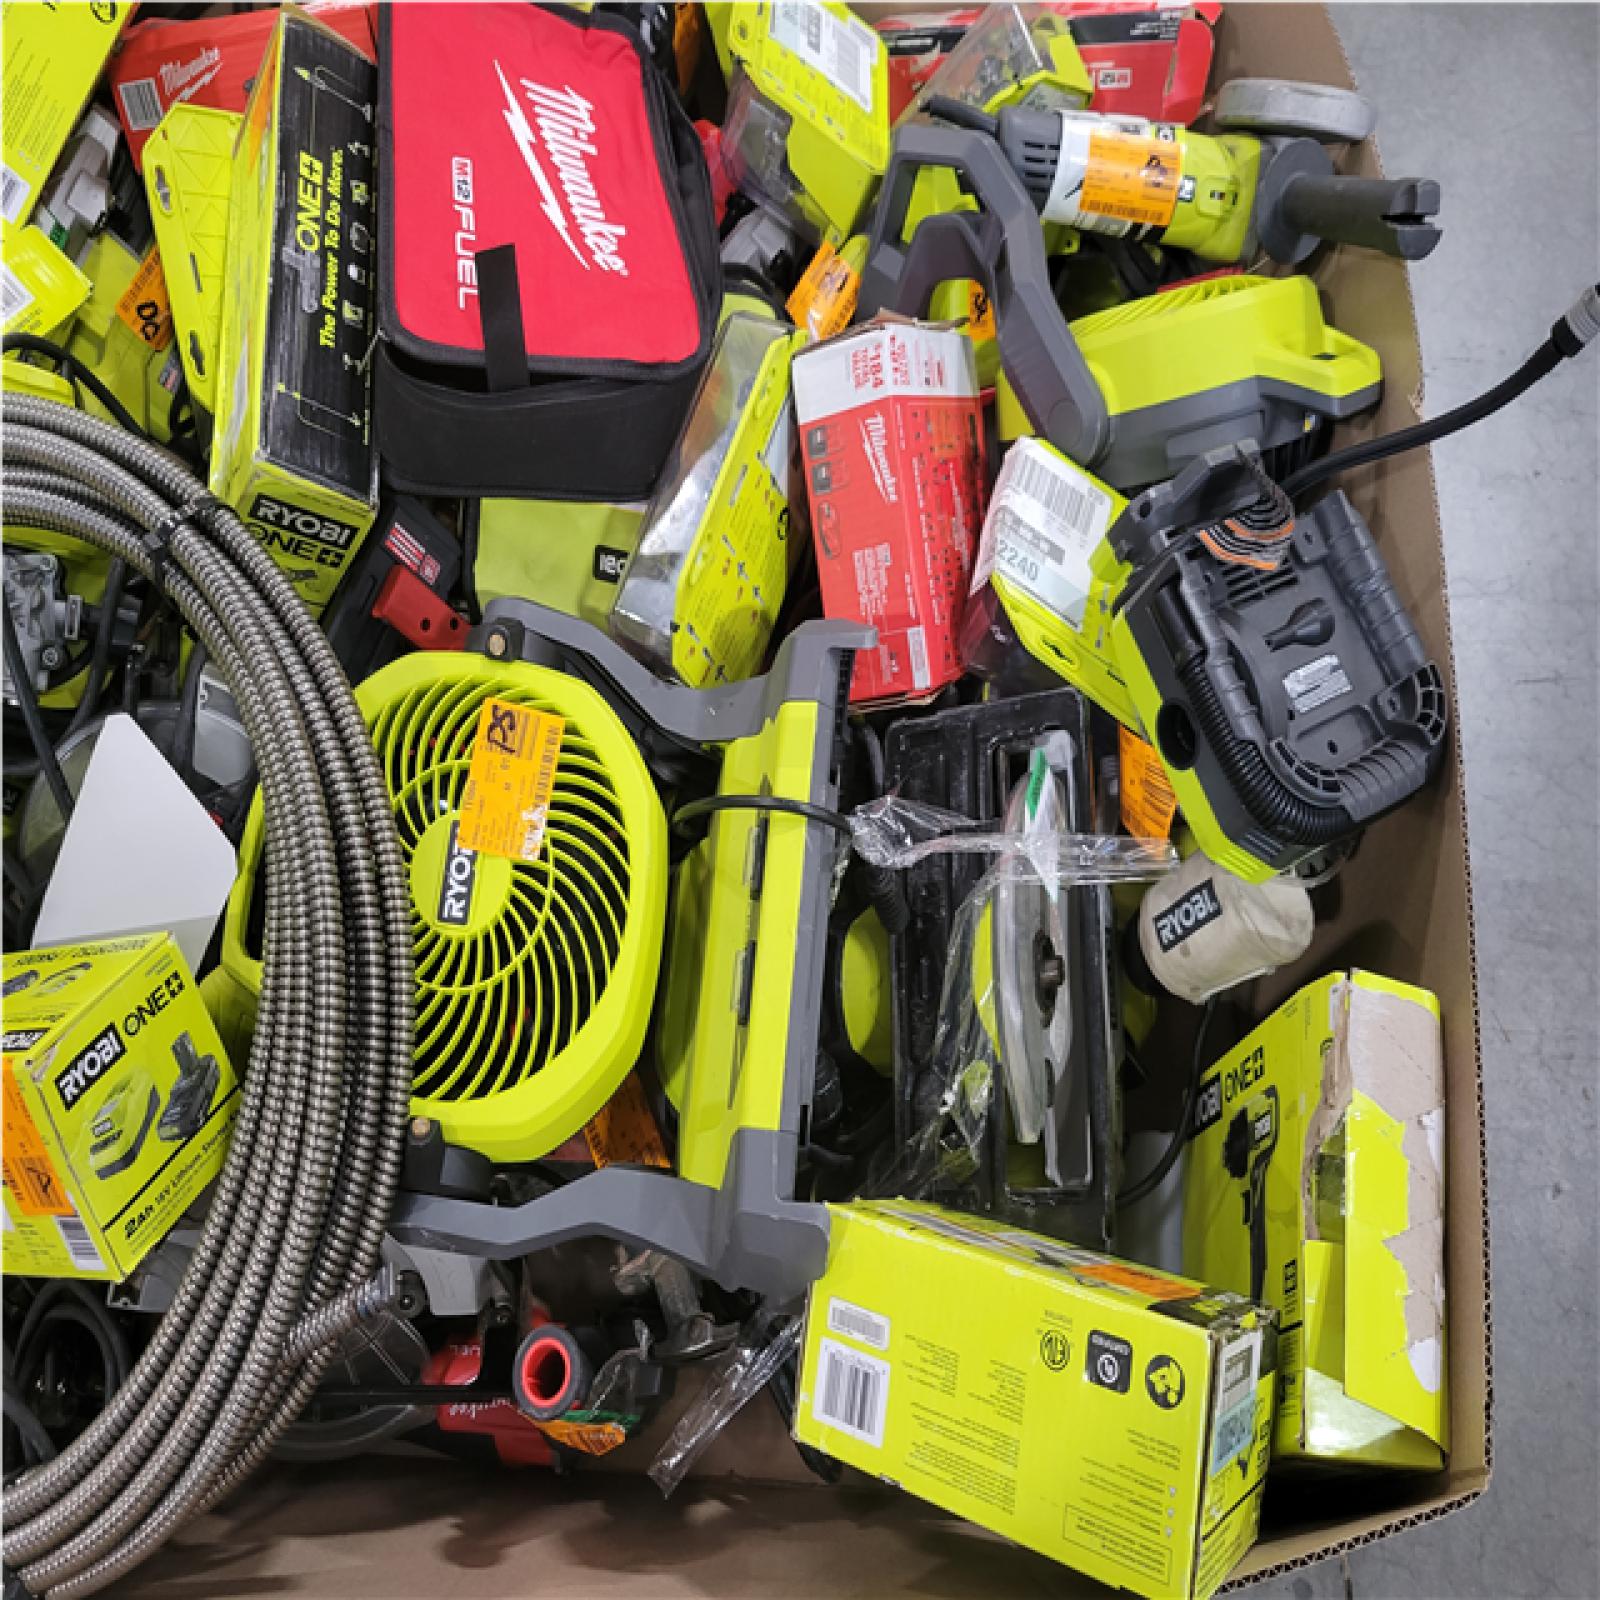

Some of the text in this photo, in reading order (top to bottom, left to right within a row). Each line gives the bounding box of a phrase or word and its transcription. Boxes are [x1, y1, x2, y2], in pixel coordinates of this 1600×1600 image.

[519, 77, 628, 276] Milwaukee
[324, 229, 341, 249] To
[325, 200, 341, 227] Do
[453, 157, 479, 310] M12 FUEL
[321, 252, 339, 311] Power
[319, 313, 336, 349] The
[863, 411, 898, 502] Milwaukee
[256, 499, 352, 546] RYOBI
[1157, 889, 1212, 945] RYOBI
[58, 1029, 122, 1103] RYOBI
